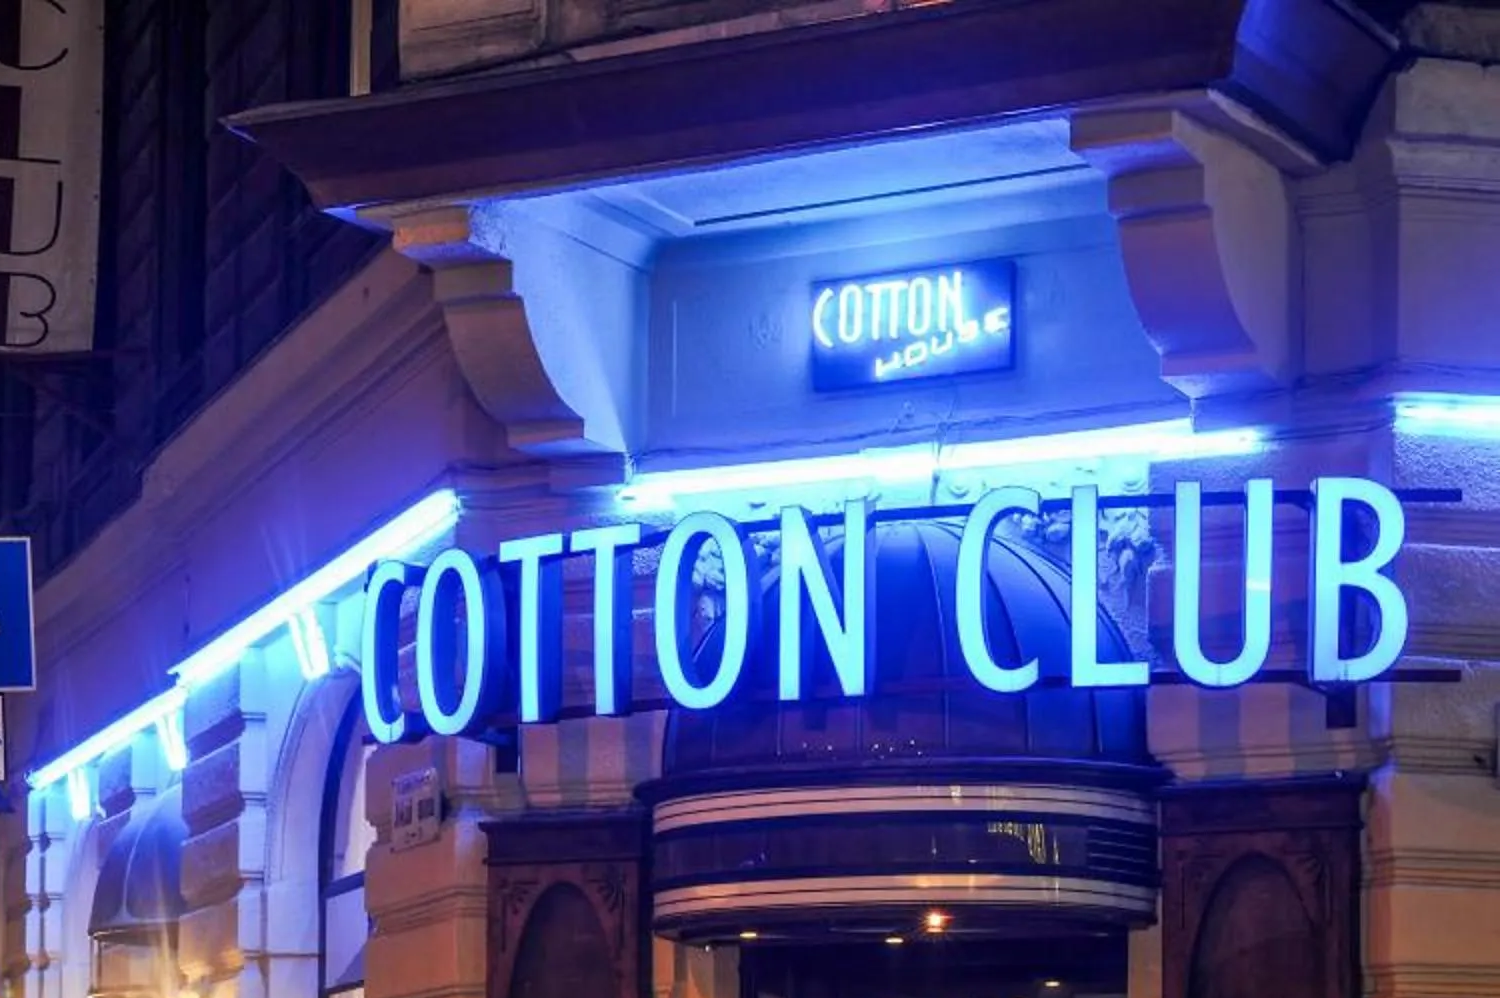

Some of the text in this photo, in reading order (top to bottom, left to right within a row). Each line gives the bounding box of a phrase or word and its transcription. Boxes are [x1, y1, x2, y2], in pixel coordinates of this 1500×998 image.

[812, 271, 964, 349] COTTON
[361, 477, 1409, 744] COTTON CLUB
